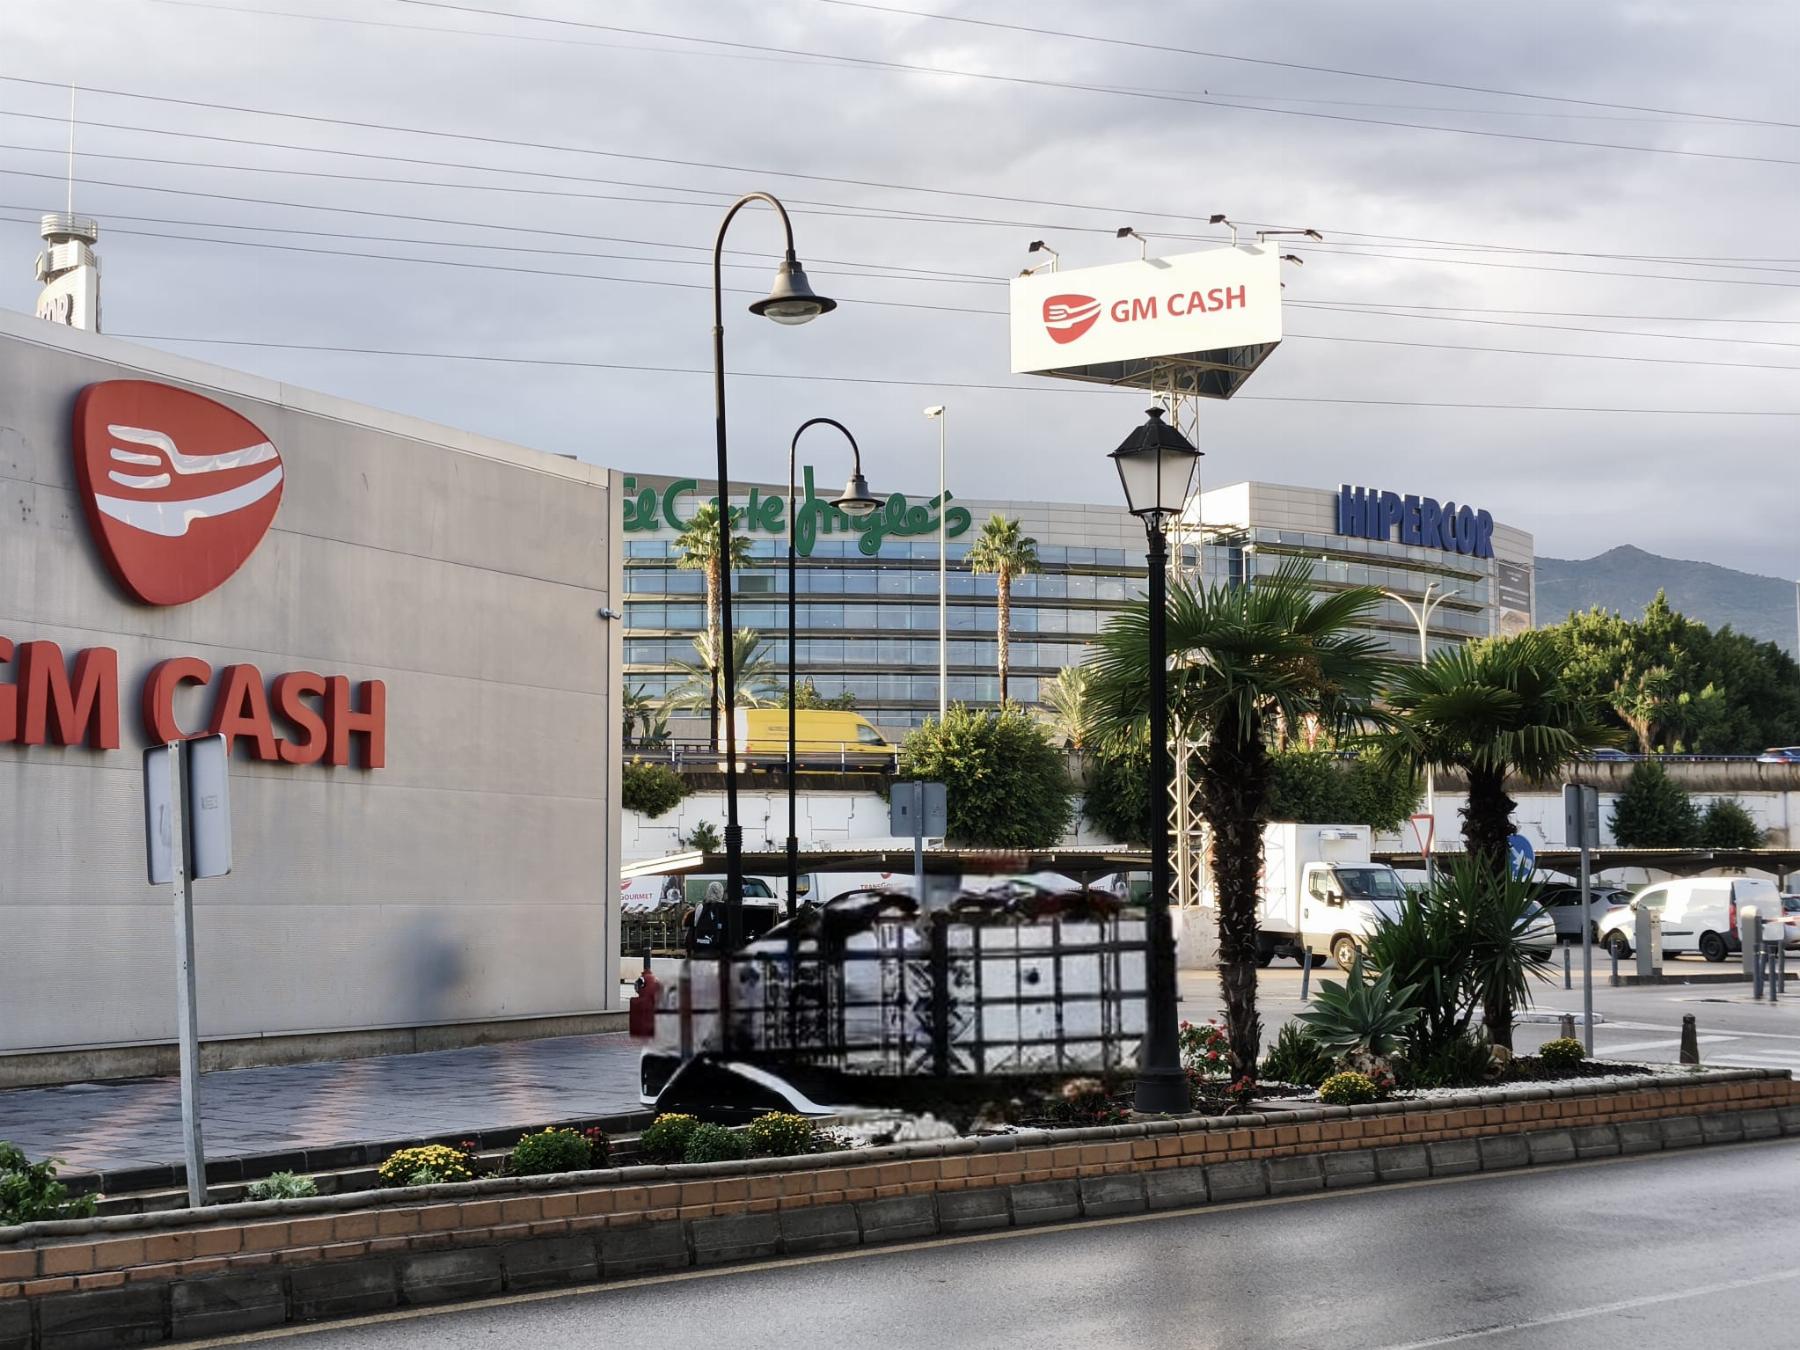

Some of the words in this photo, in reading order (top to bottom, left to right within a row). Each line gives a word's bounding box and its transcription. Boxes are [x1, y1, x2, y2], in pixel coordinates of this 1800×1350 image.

[1110, 296, 1157, 322] GM
[1167, 285, 1246, 316] CASH
[796, 465, 972, 557] Inglés
[1337, 484, 1494, 558] HIPERCOR
[0, 636, 119, 750] M
[143, 656, 386, 769] CASH
